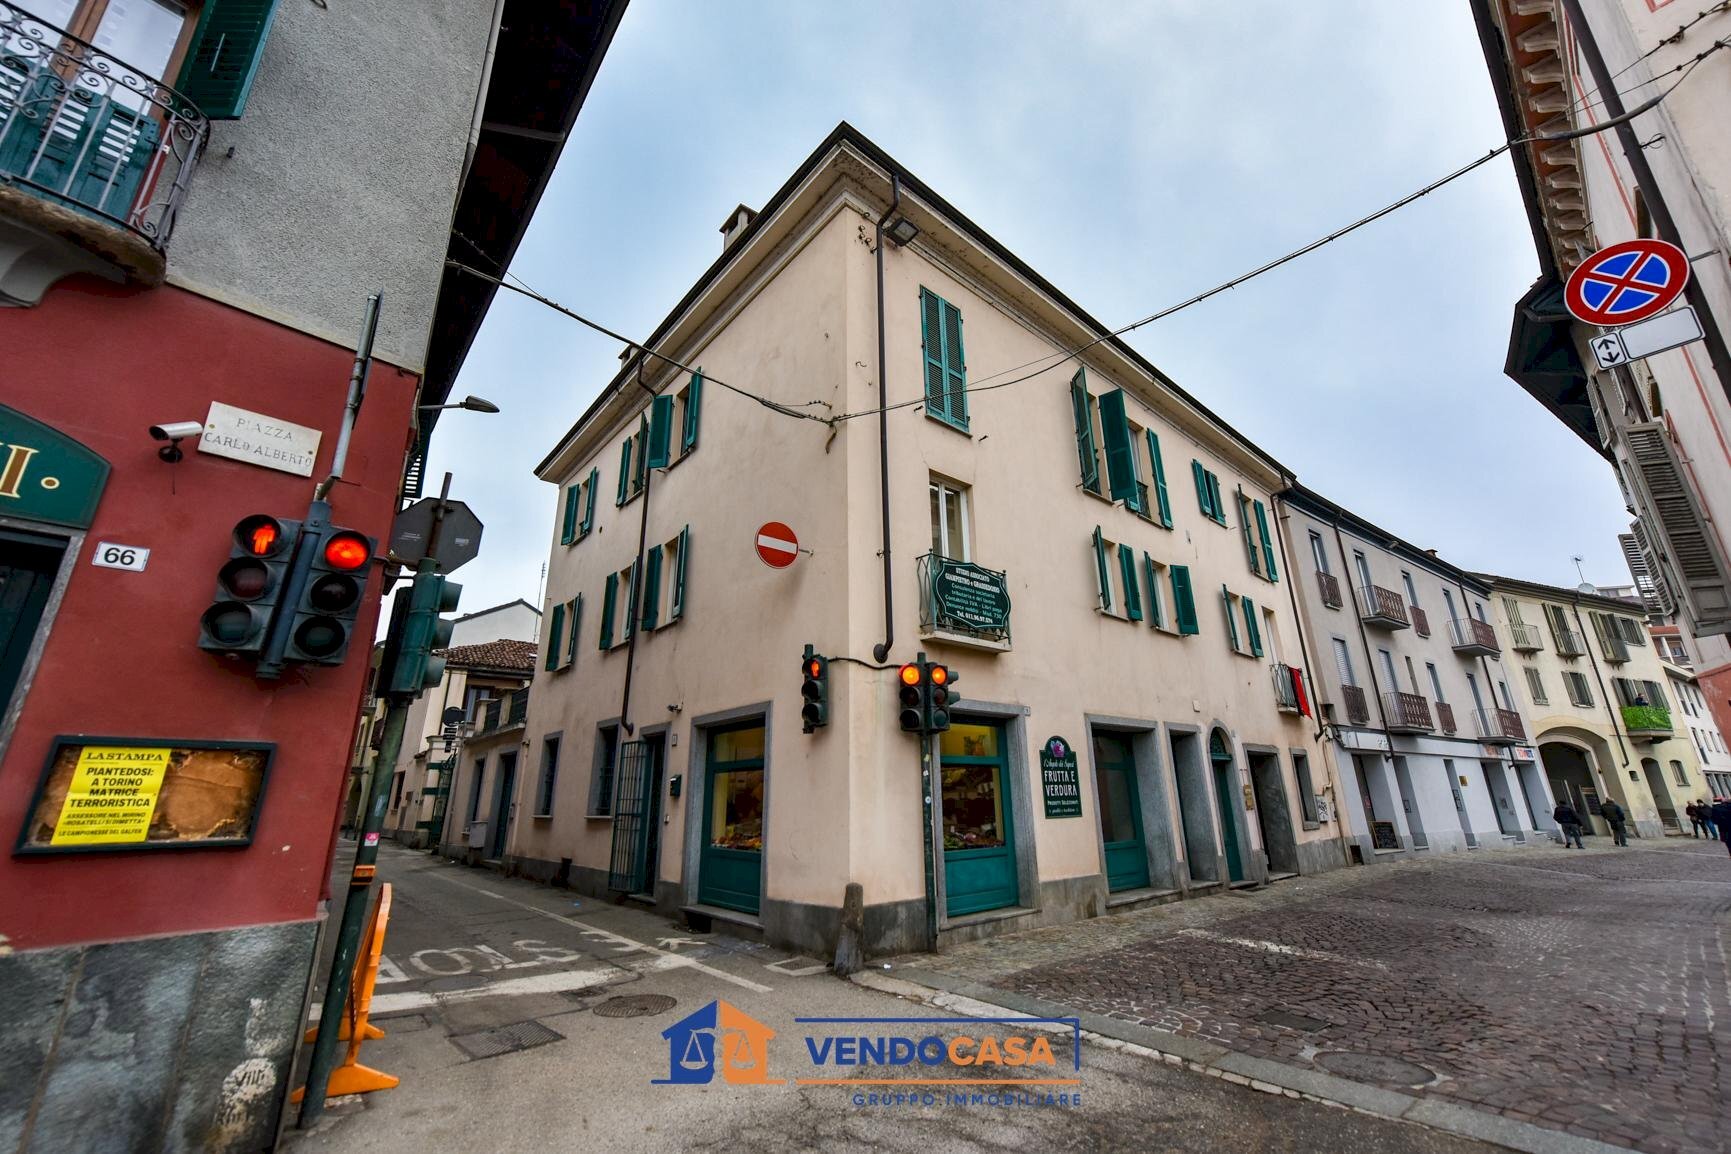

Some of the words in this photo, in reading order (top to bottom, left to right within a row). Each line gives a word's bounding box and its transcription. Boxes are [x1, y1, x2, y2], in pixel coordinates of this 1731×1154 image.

[236, 418, 293, 441] PIAZZA
[204, 432, 250, 451] CARLO
[254, 445, 312, 467] ALBERTO
[104, 547, 136, 565] 66
[86, 752, 105, 760] LA
[105, 753, 164, 761] STAMPA
[86, 767, 154, 776] PIANTEDOSI:
[1044, 770, 1069, 782] FRUTTA
[1070, 770, 1075, 782] E
[91, 778, 99, 786] A
[102, 778, 143, 786] TORINO
[89, 788, 140, 796] MATRICE
[1045, 784, 1078, 797] VERDURA
[70, 799, 150, 808] TERRORISTICA
